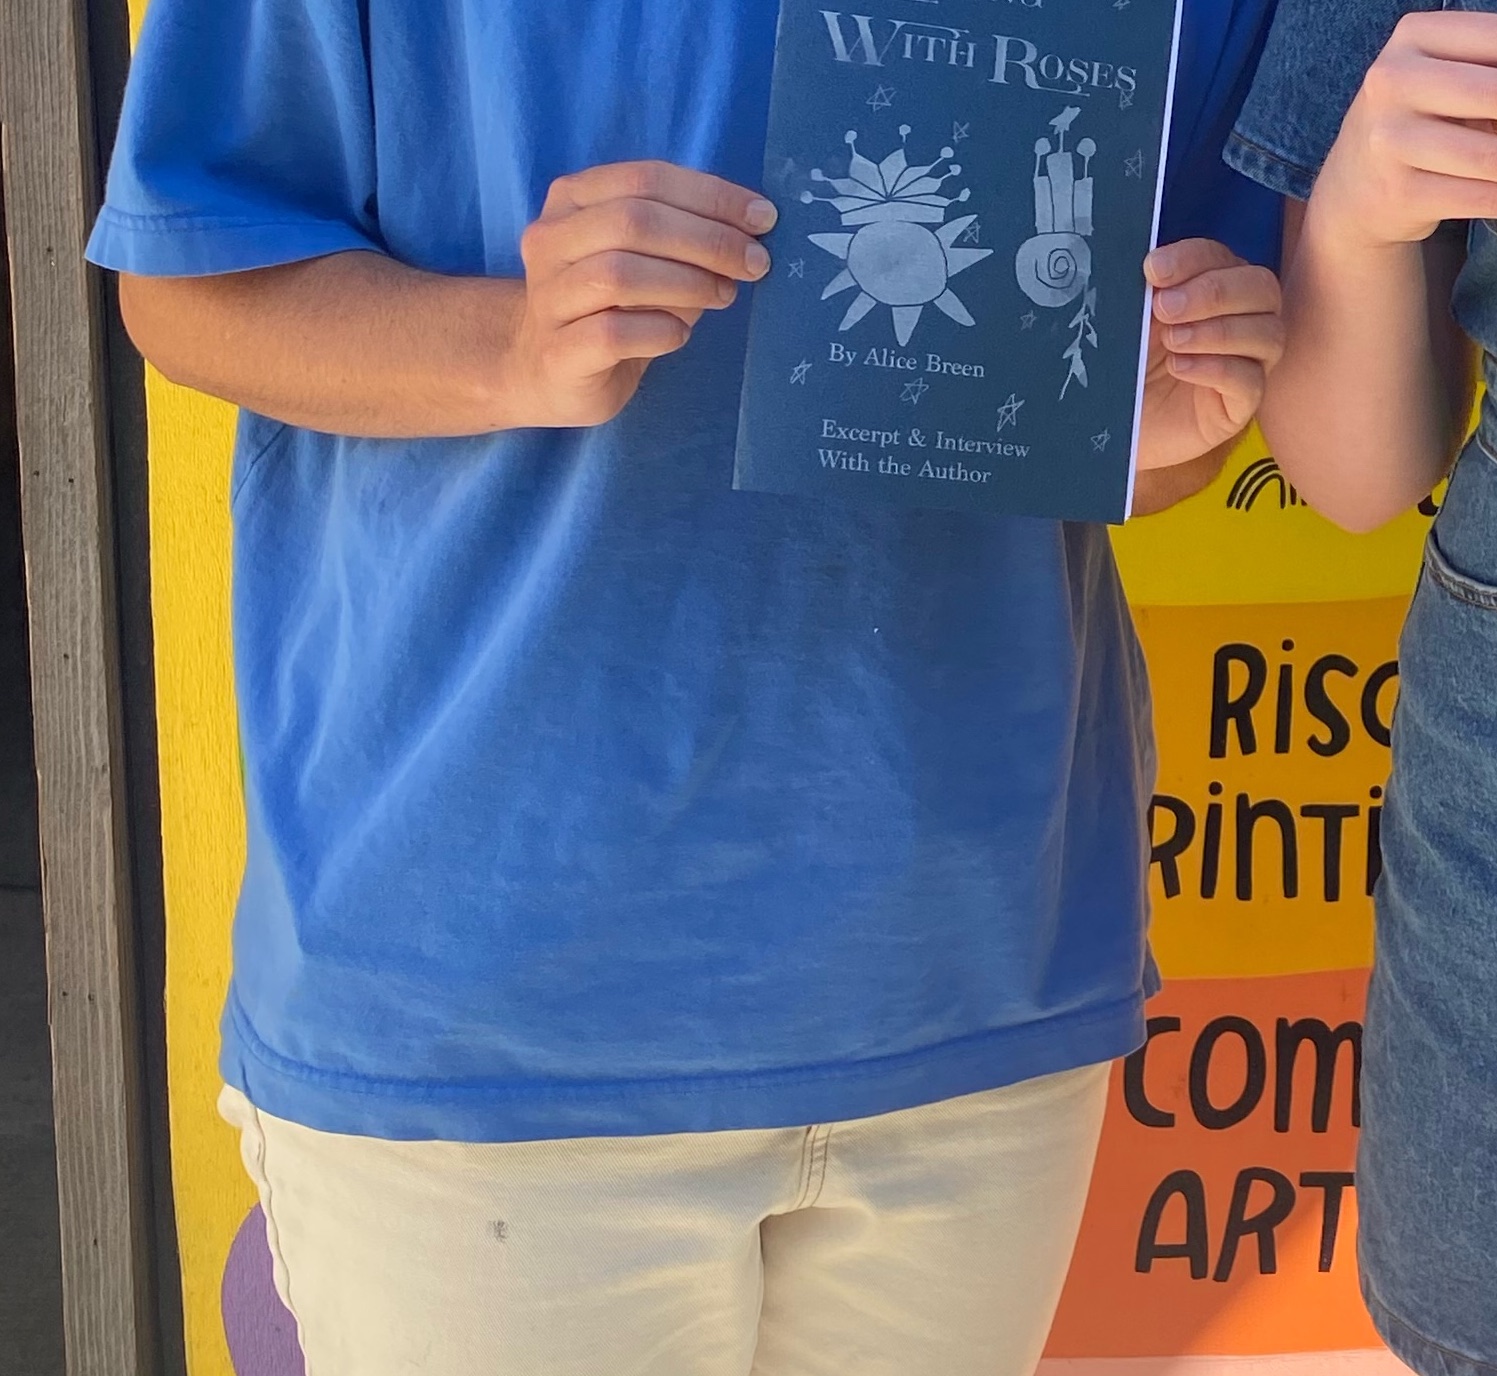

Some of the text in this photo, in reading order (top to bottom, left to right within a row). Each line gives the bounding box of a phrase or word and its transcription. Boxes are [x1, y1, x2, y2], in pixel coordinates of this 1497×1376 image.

[829, 342, 985, 378] By Alice Breen
[821, 419, 1031, 458] Excerpt & Interview
[818, 449, 992, 483] With the Author
